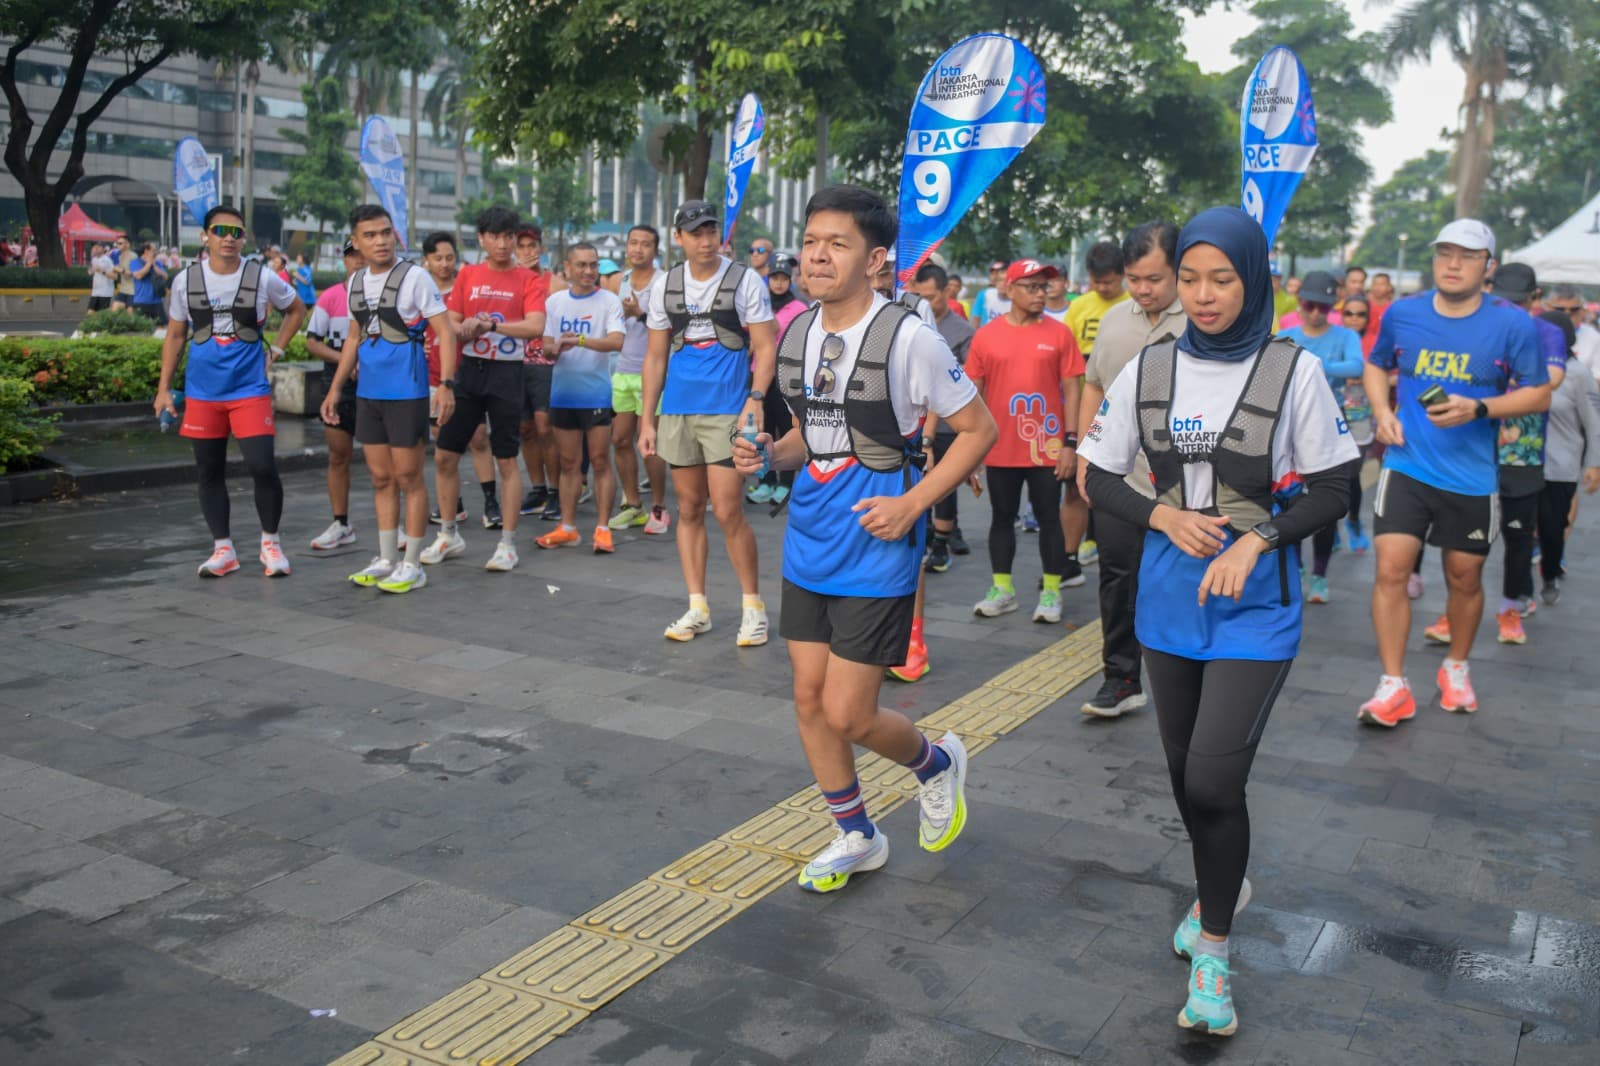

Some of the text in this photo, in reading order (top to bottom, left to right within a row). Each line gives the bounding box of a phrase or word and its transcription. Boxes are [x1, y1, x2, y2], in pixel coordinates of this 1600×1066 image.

[941, 64, 961, 76] btn
[938, 78, 1005, 93] INTERNATIONAL
[939, 73, 977, 85] JAKARTA
[938, 88, 985, 101] MARATHON
[917, 126, 981, 152] PACE
[913, 160, 951, 216] 9
[560, 314, 592, 334] btn
[1173, 414, 1203, 432] btn
